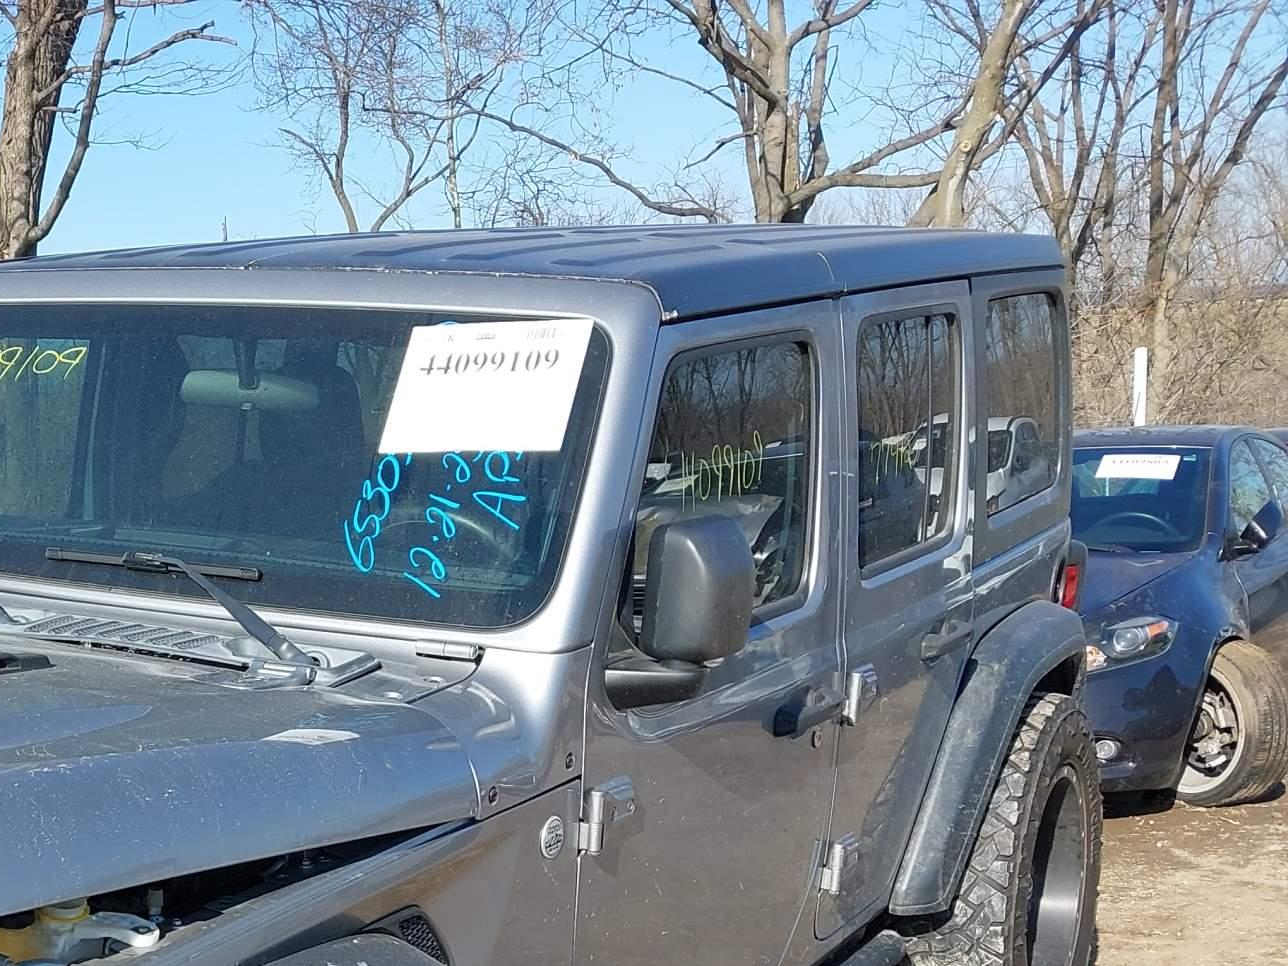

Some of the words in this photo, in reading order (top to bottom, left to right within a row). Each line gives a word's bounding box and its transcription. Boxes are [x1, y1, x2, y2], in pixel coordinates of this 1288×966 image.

[419, 349, 561, 376] 44099109
[344, 451, 413, 573] 6530
[403, 450, 484, 598] 12.21.2
